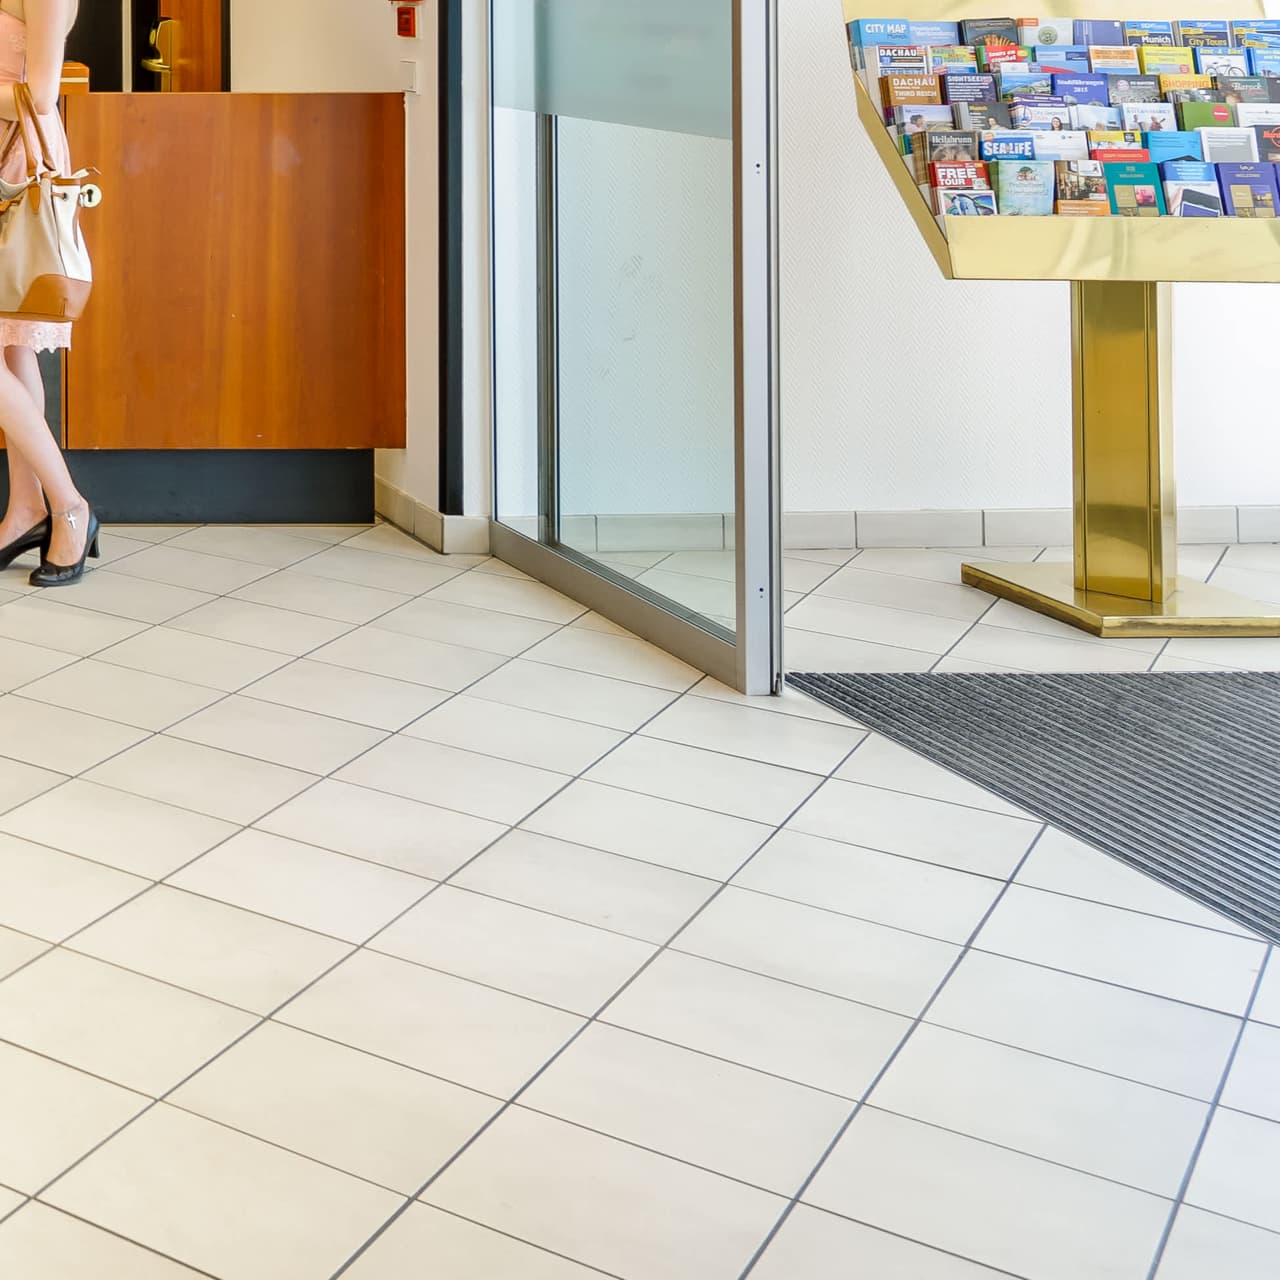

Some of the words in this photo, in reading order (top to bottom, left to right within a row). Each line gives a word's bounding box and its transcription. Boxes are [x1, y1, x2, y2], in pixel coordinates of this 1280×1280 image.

[865, 23, 884, 34] CITY
[887, 23, 907, 34] MAP
[1142, 35, 1171, 45] Munich
[880, 48, 917, 57] DACHAU
[892, 77, 936, 87] DACHAU
[1162, 79, 1209, 89] SHOPPING
[984, 141, 1007, 156] SEA
[938, 168, 977, 179] FREE
[939, 178, 966, 186] TOUR
